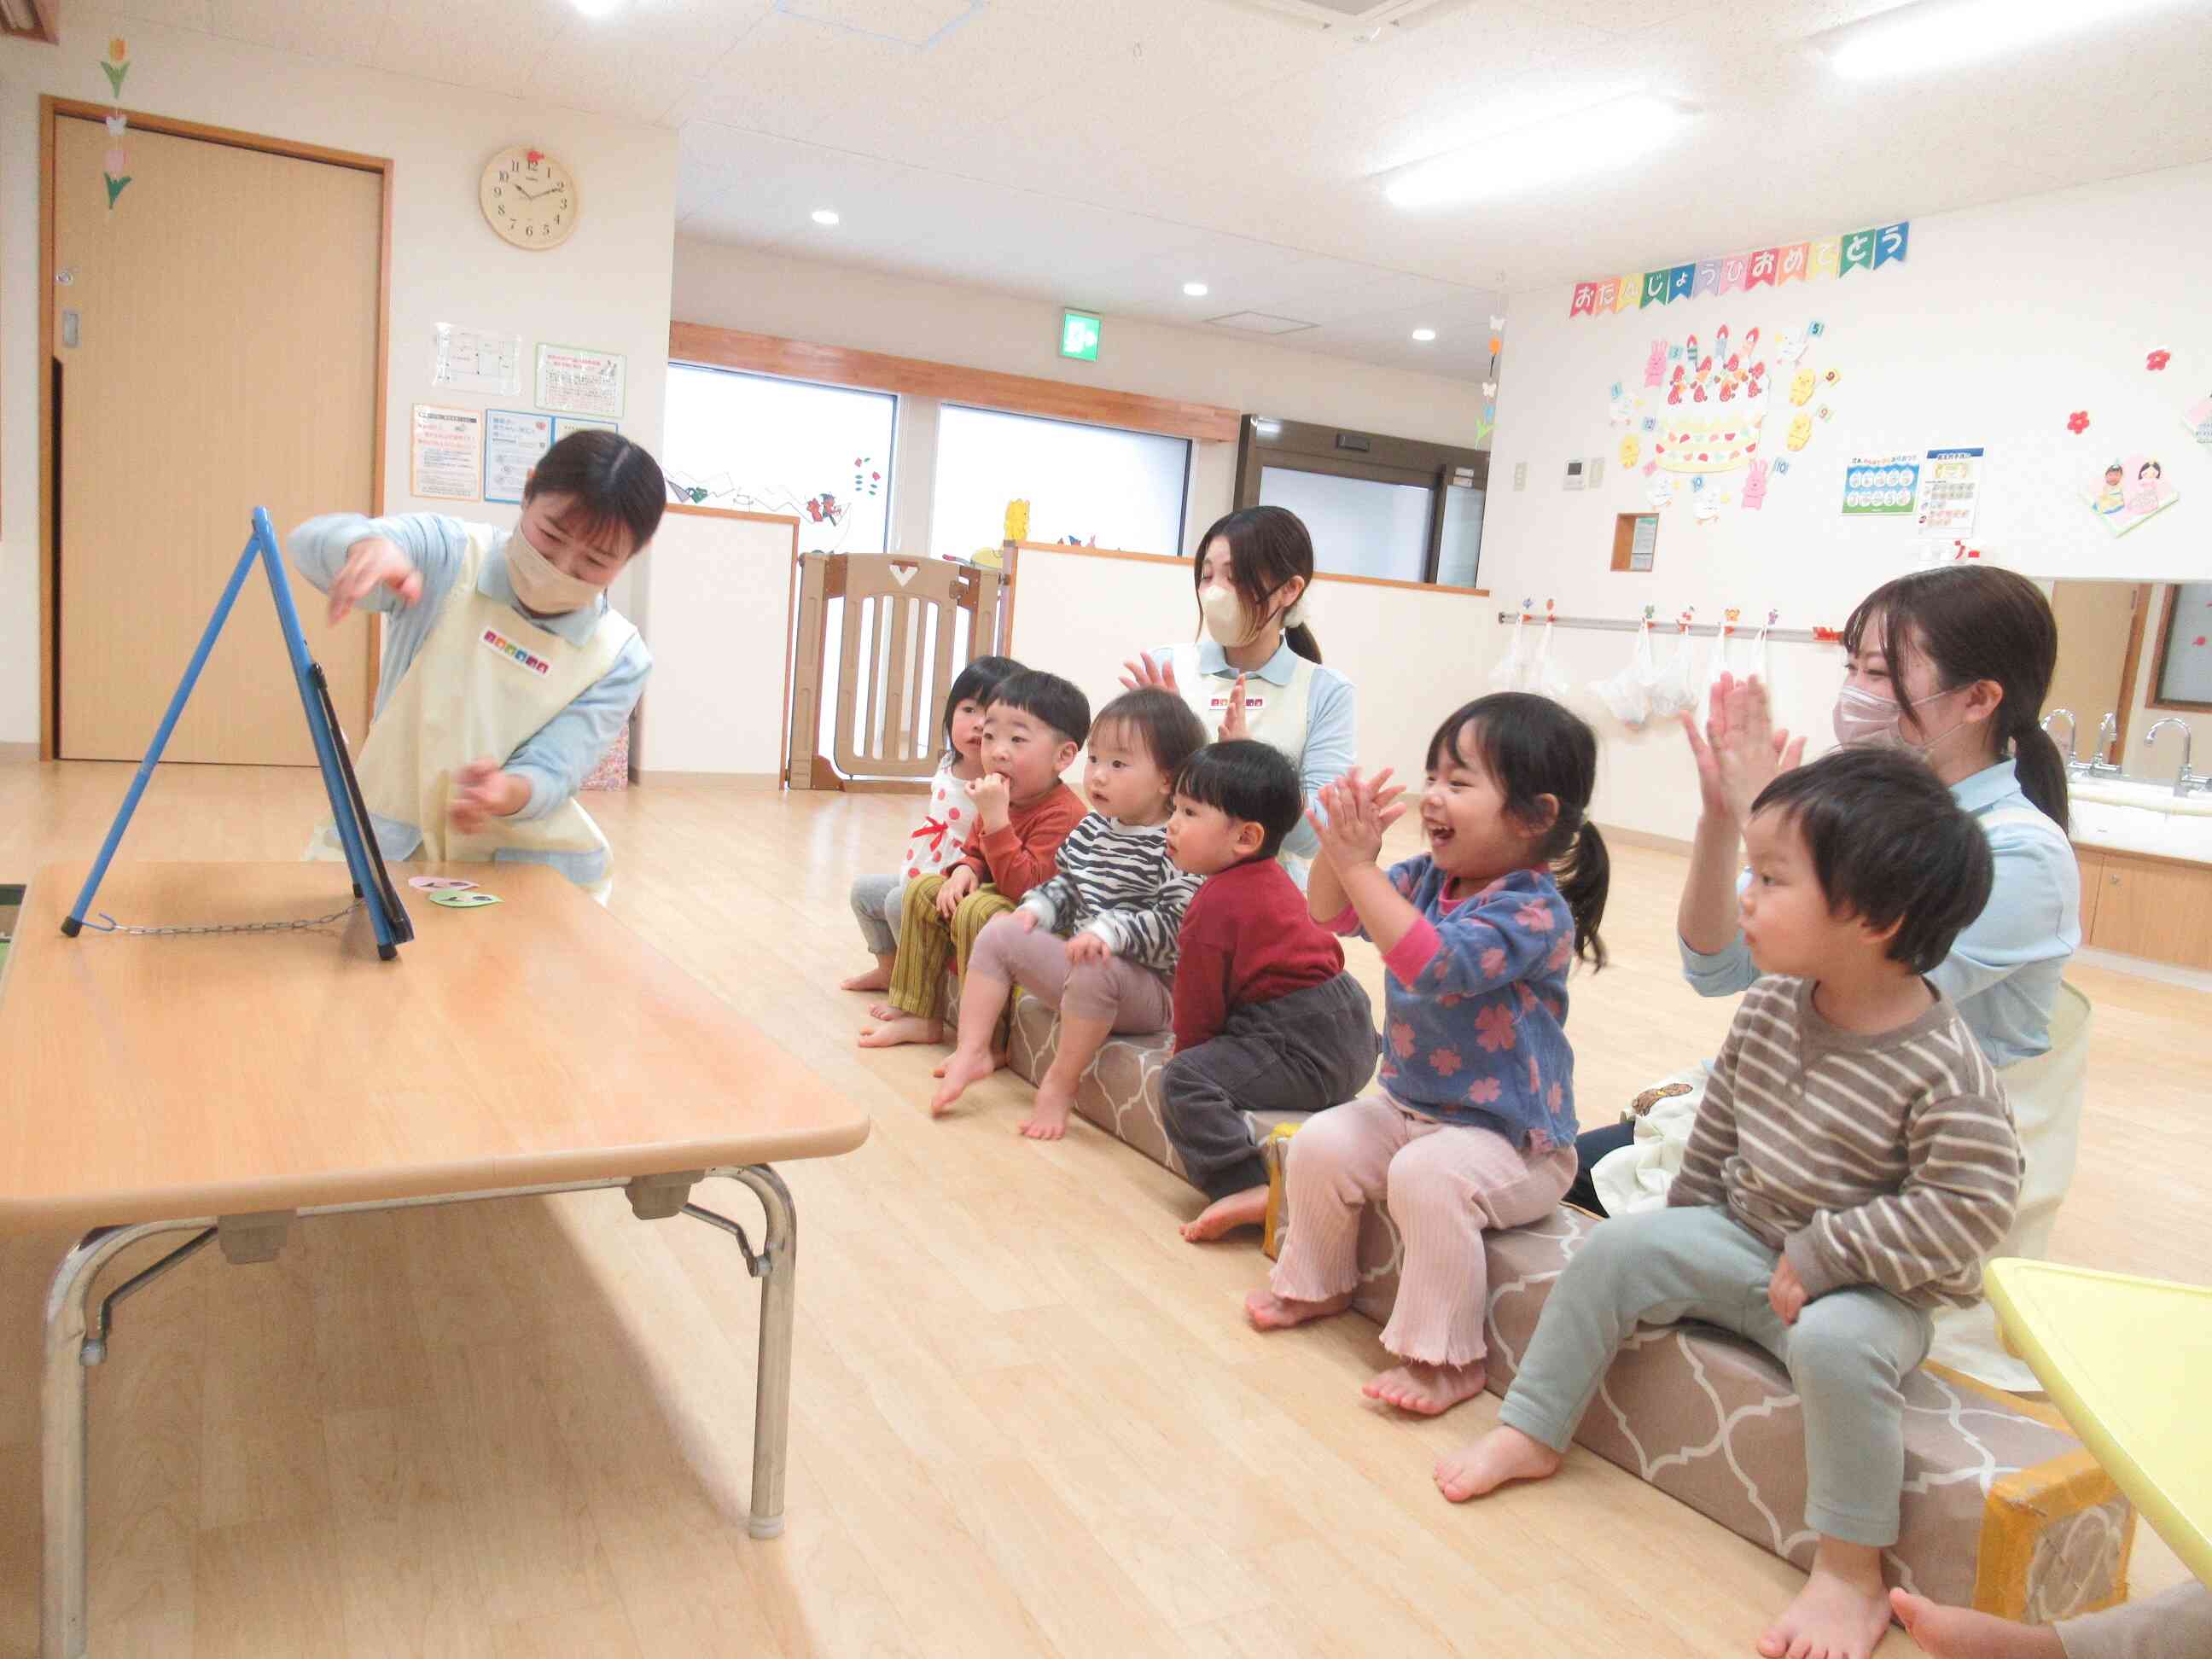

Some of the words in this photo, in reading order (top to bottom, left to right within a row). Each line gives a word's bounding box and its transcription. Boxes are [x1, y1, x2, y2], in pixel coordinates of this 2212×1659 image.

[511, 160, 520, 172] 11
[527, 160, 538, 172] 12
[546, 166, 551, 178] 1
[499, 170, 509, 183] 10
[493, 186, 502, 197] 9
[498, 205, 505, 215] 8
[560, 198, 568, 210] 3
[509, 218, 517, 230] 7
[553, 214, 560, 225] 4
[526, 225, 533, 236] 6
[544, 224, 550, 236] 5
